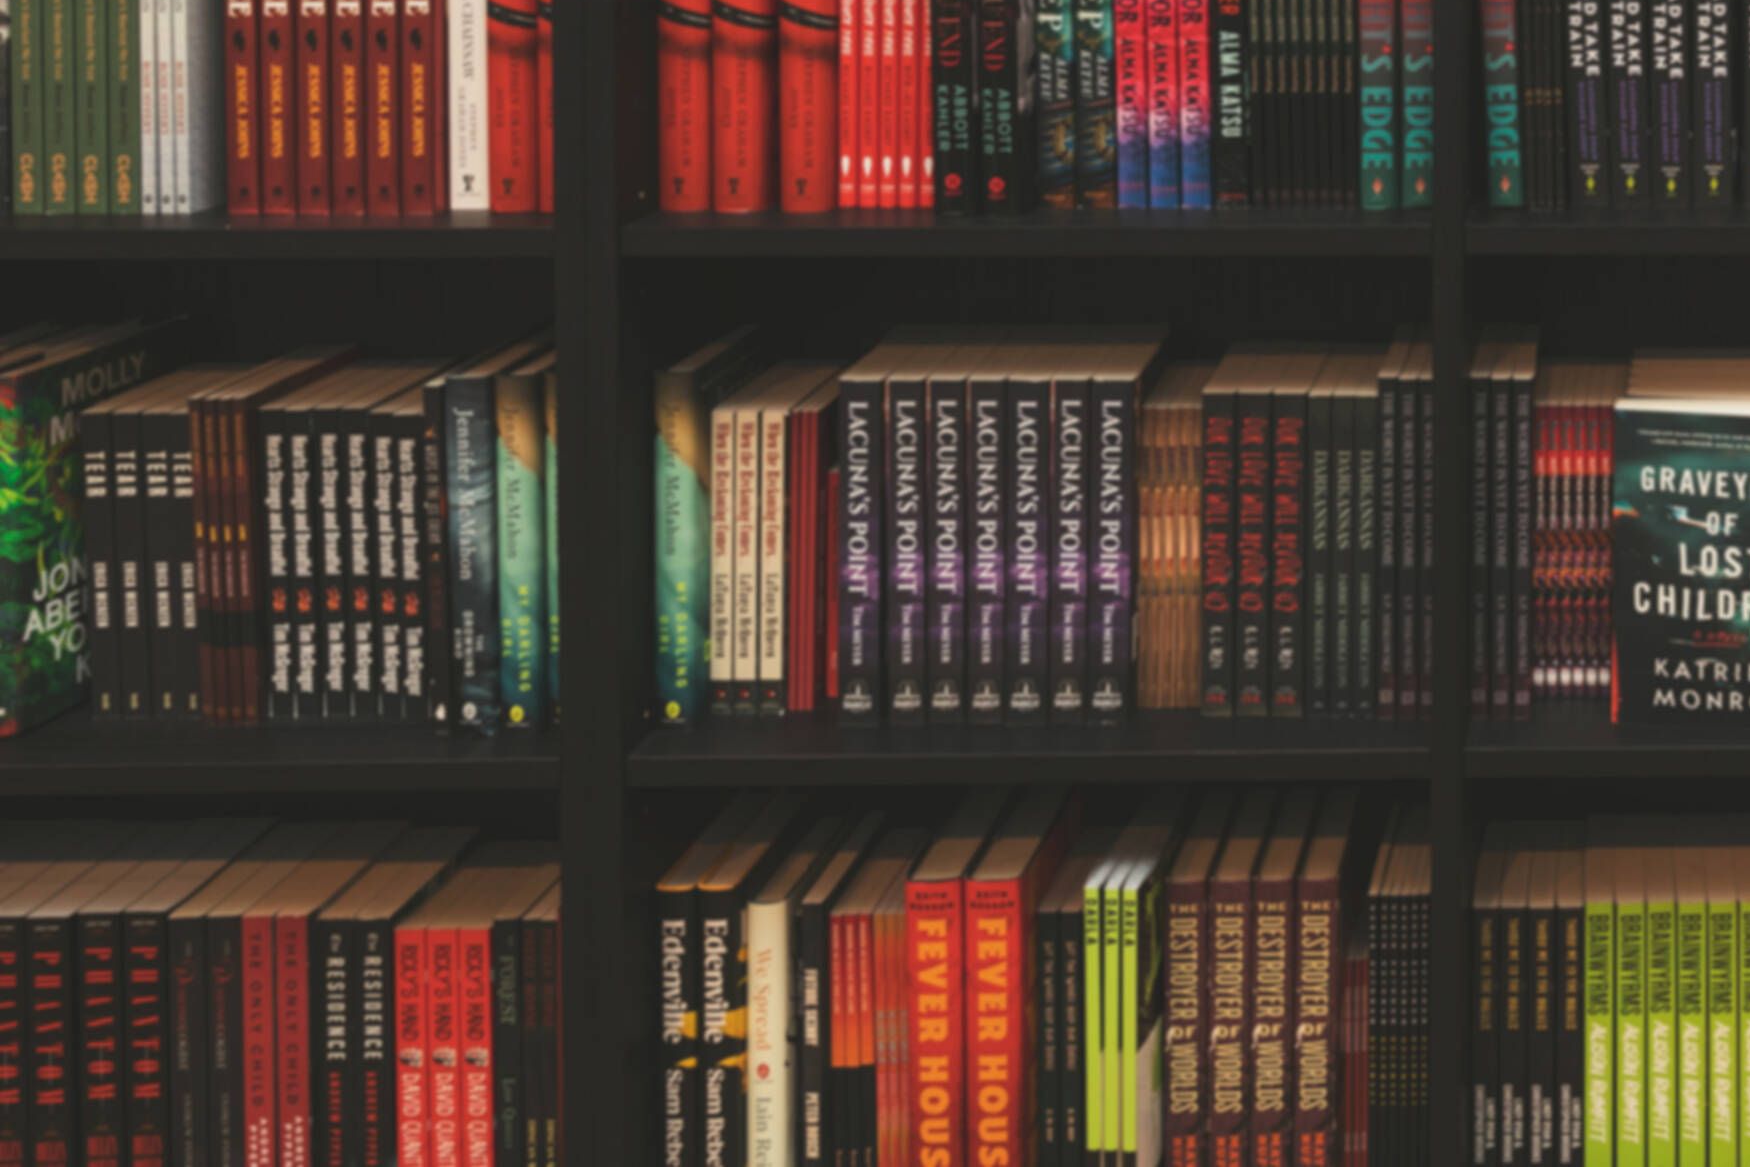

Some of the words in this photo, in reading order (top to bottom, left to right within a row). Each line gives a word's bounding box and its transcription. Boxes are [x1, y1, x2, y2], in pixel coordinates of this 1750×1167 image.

[1218, 31, 1241, 78] ALMA
[1568, 1, 1584, 68] TRAIN
[1583, 21, 1600, 78] TAKE
[936, 84, 951, 152] KAHLER
[952, 85, 969, 152] ABBOTT
[1220, 85, 1242, 139] KATSU
[1360, 86, 1393, 170] EDGE
[61, 352, 147, 407] MOLLY
[1016, 400, 1039, 515] LACUNA'S
[1706, 512, 1739, 536] OF
[1016, 520, 1038, 597] POINT
[1171, 903, 1199, 913] THE
[248, 933, 264, 971] THE
[661, 919, 686, 1045] Edenville
[917, 918, 948, 1044] FEVER
[1169, 917, 1199, 1021] DESTROYER
[1649, 911, 1672, 1014] BRAINWYRMS
[248, 977, 264, 1035] ONLY
[364, 954, 385, 1062] RESIDENCE
[249, 1041, 264, 1108] CHILD
[667, 1067, 683, 1115] Sam
[1169, 1041, 1198, 1114] WORLDS
